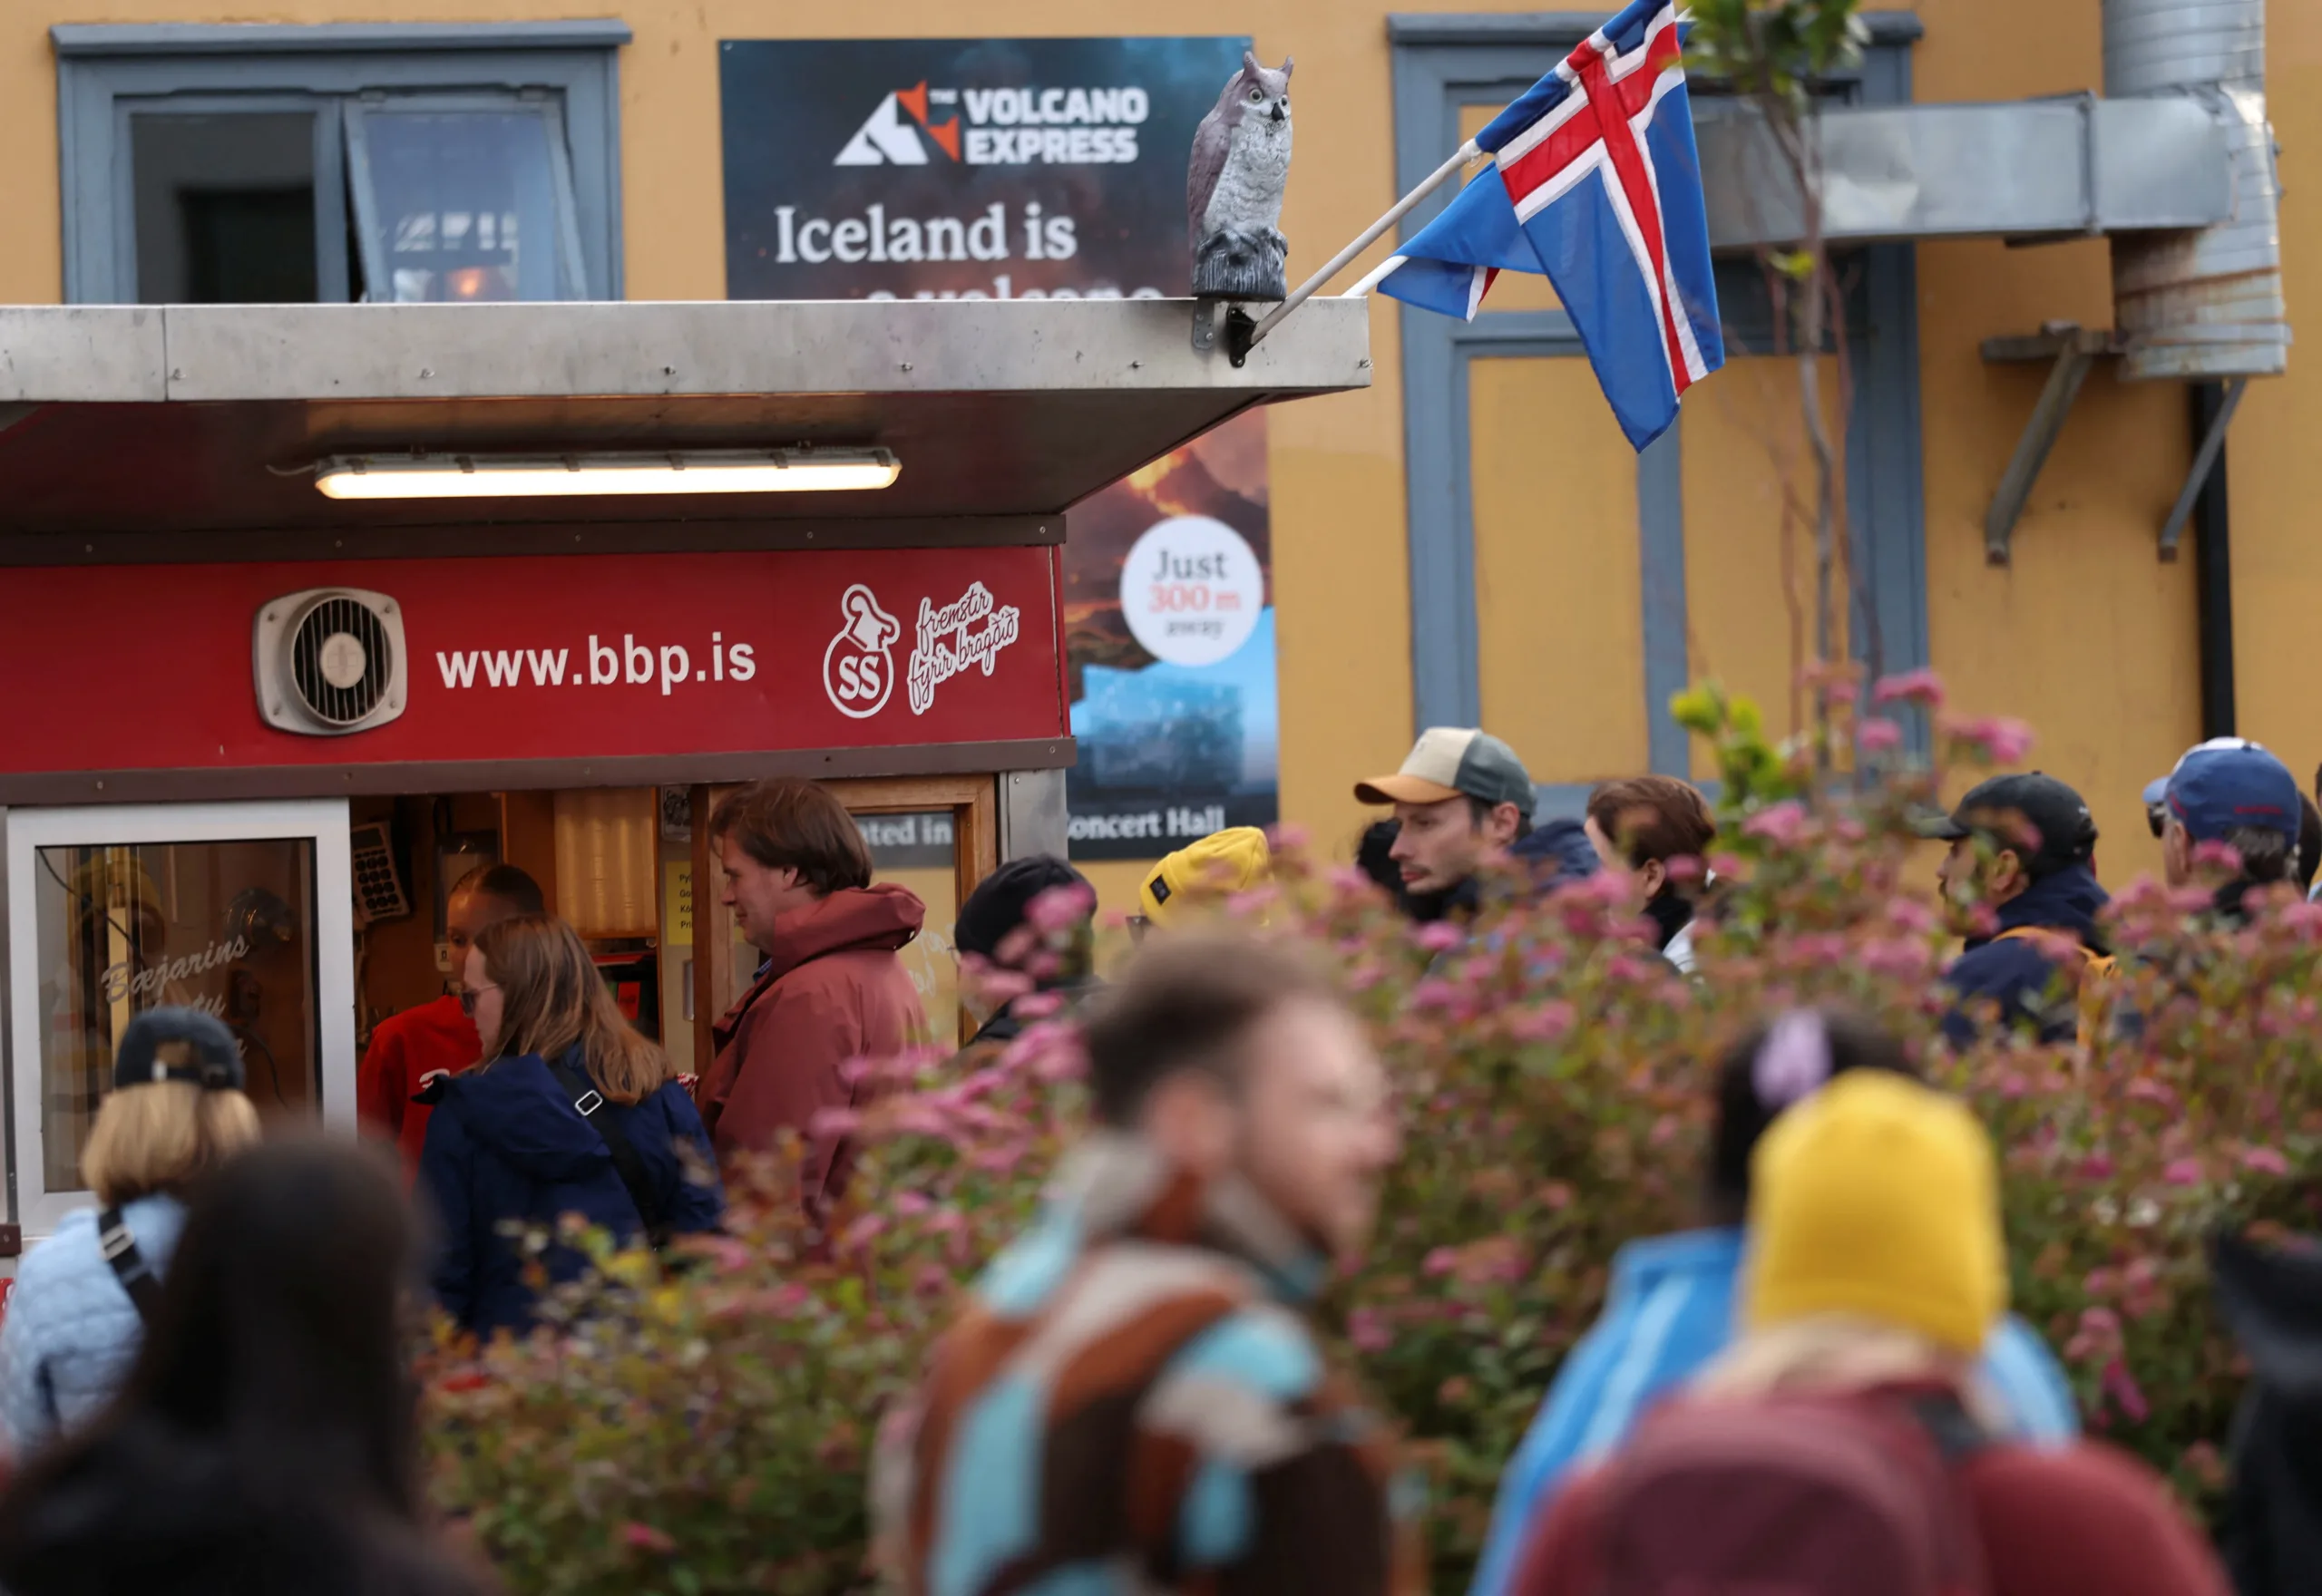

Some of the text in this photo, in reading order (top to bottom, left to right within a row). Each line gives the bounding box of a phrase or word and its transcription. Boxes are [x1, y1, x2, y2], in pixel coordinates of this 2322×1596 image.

[962, 87, 1150, 125] VOLCANO
[964, 128, 1139, 165] EXPRESS
[774, 200, 1078, 263] Iceland is
[1151, 548, 1230, 581] Just
[1147, 581, 1211, 614] 300
[917, 583, 993, 659] fremstir
[435, 631, 757, 696] www.bbp.is
[837, 655, 881, 700] SS
[908, 645, 956, 713] fyrir
[921, 814, 953, 845] in
[1068, 810, 1162, 840] oncert
[1166, 803, 1225, 837] Hall
[101, 934, 249, 1005] Bæjarins
